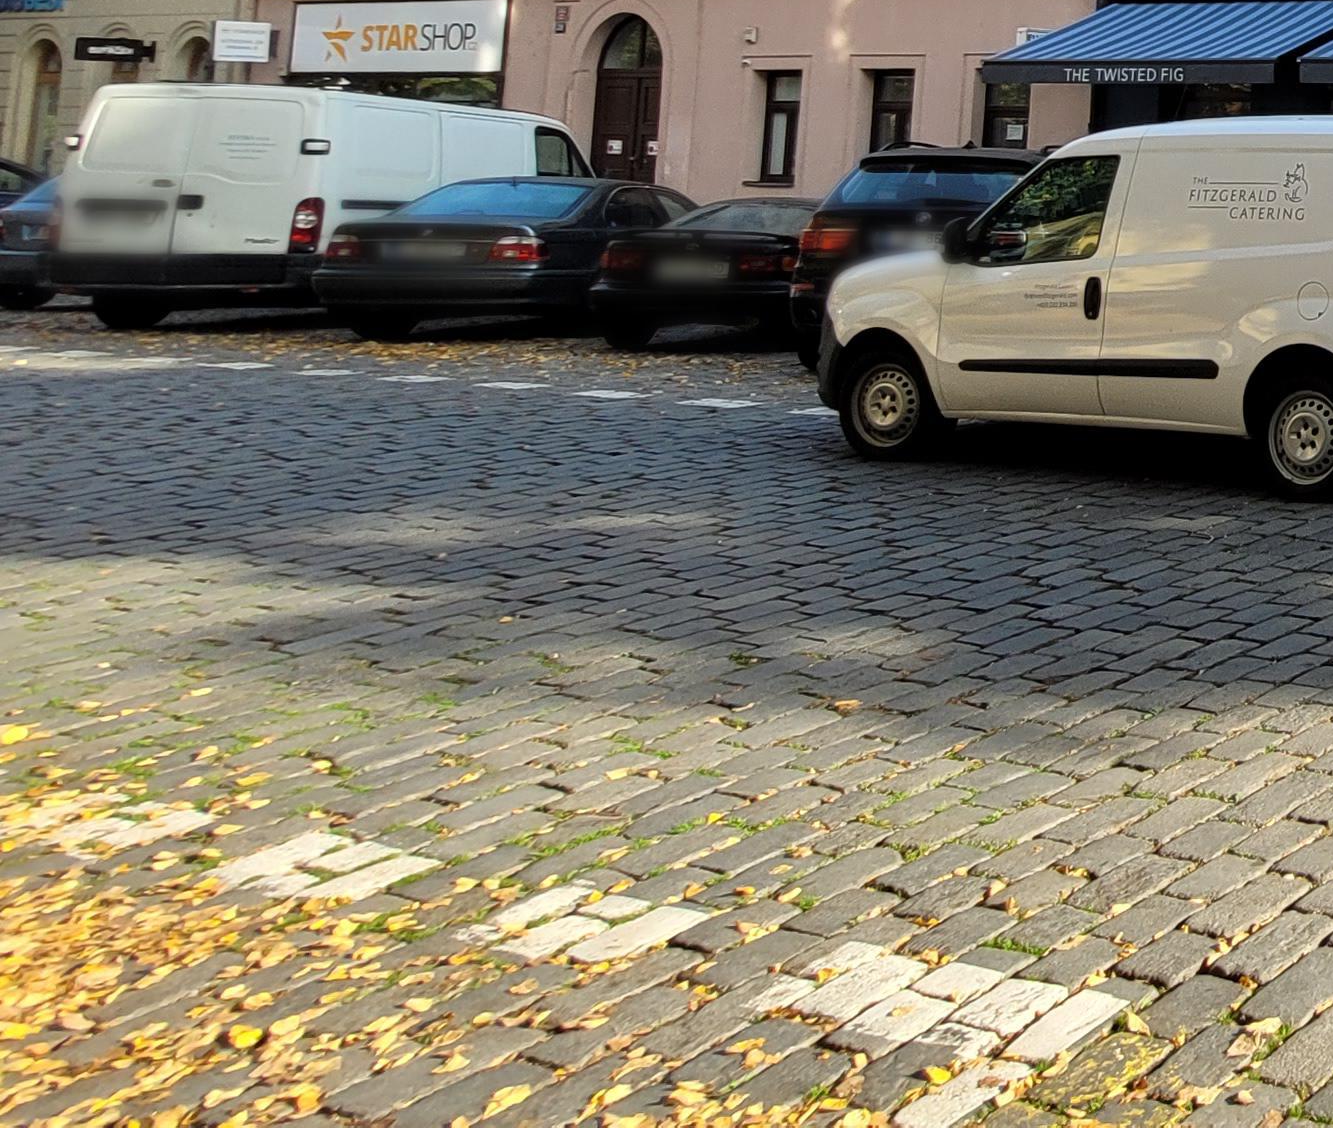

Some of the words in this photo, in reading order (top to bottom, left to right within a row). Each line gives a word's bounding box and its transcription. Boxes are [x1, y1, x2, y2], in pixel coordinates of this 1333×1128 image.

[1064, 68, 1090, 82] THE
[1095, 68, 1157, 83] TWISTED
[1161, 68, 1184, 82] FIG
[1193, 177, 1208, 185] THE
[1189, 189, 1277, 202] FITZGERALD
[1229, 207, 1304, 220] CATERING
